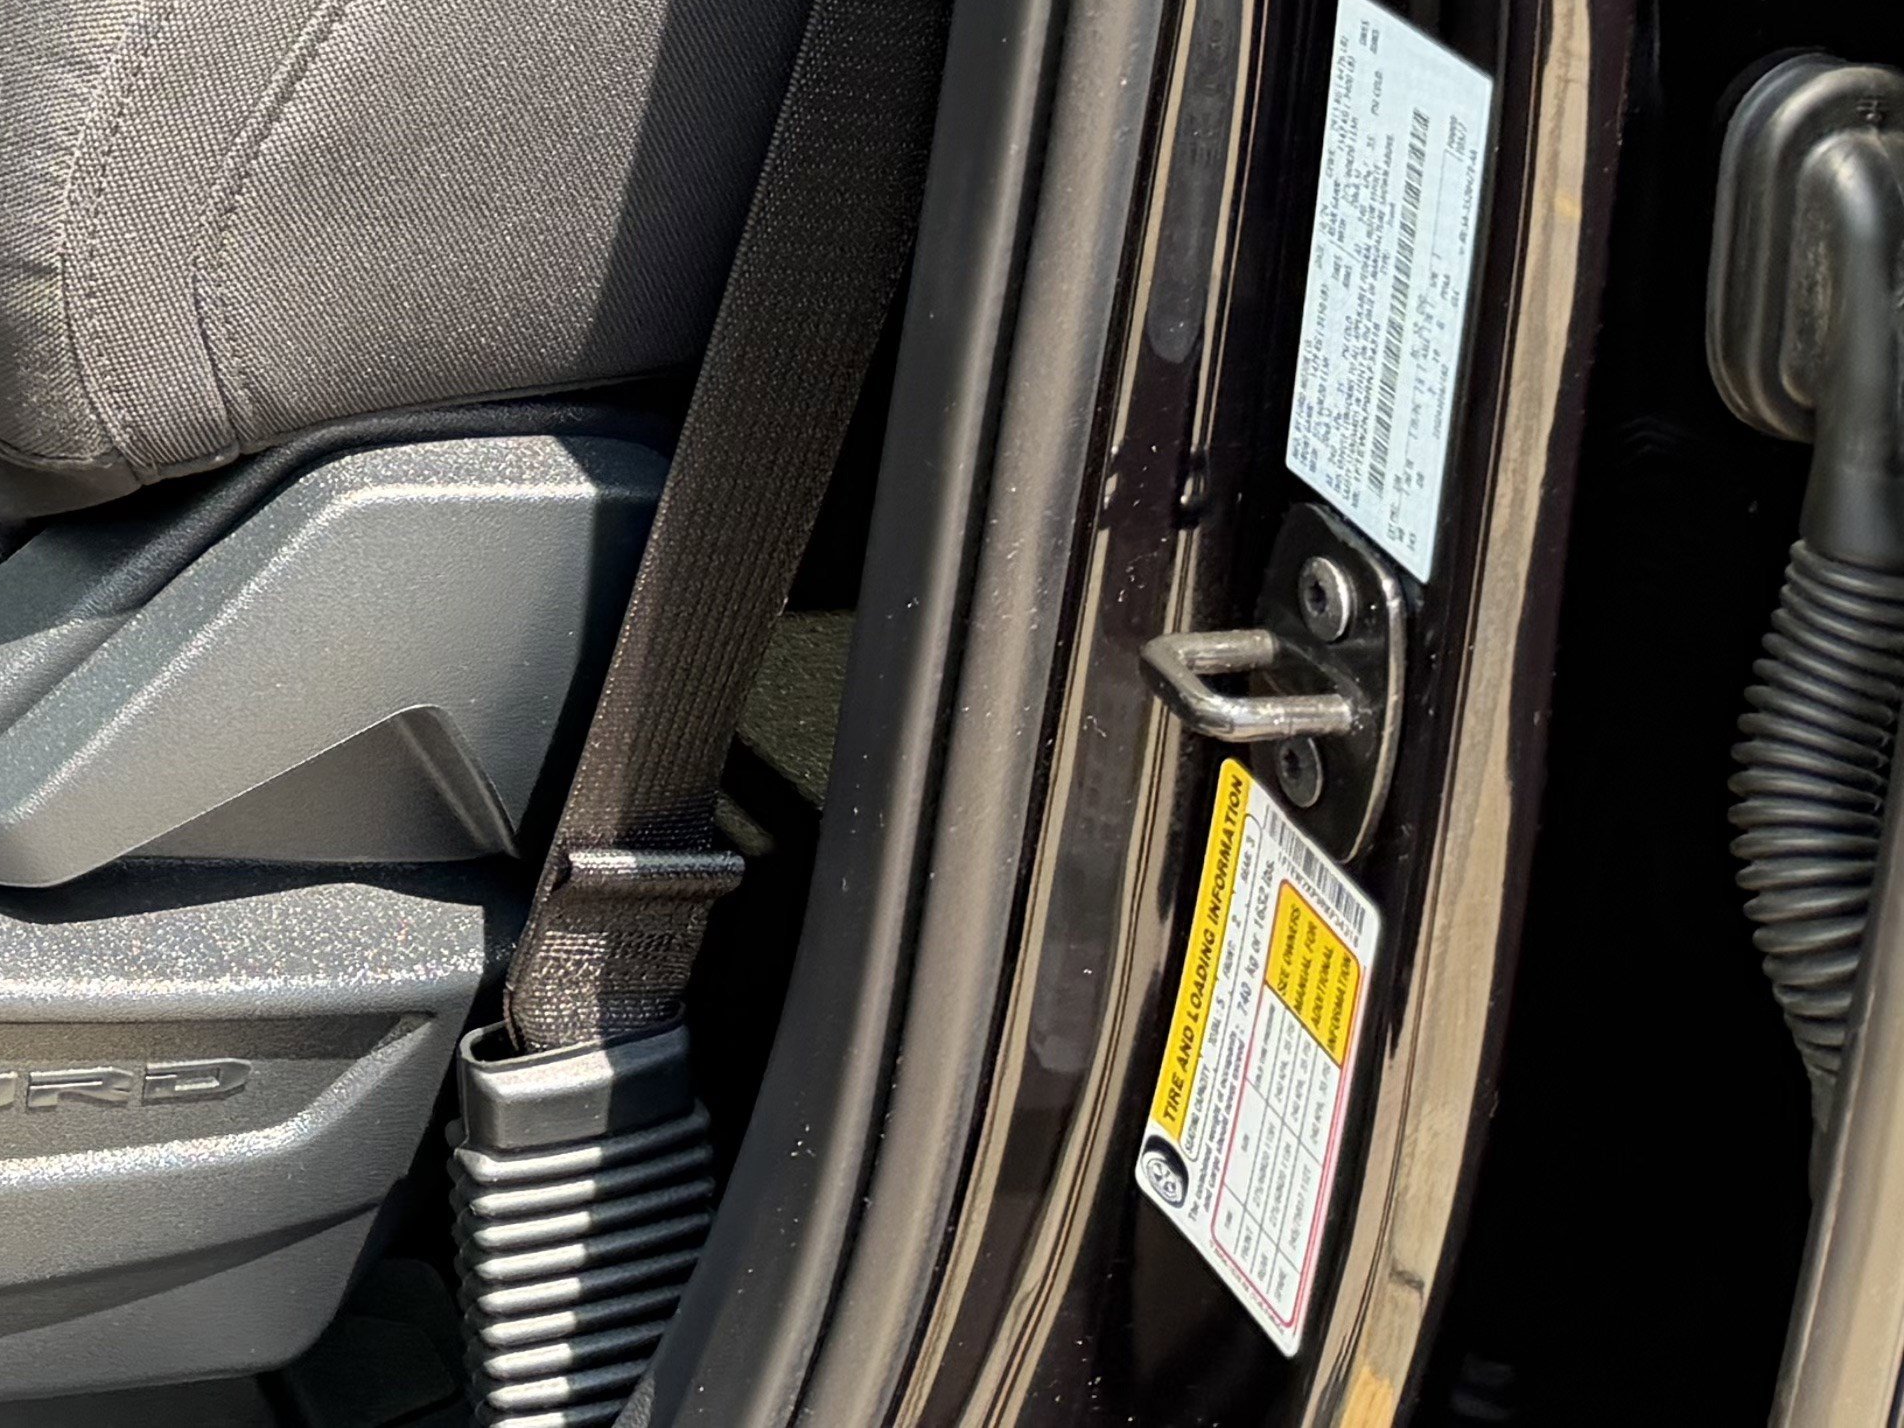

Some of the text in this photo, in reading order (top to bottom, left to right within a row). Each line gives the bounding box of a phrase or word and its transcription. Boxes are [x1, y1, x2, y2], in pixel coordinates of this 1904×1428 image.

[1163, 771, 1243, 1128] TIRE AND LOADING INFORMATION
[1276, 965, 1289, 997] SEE
[1291, 918, 1317, 1016] MANUAL FOR
[1309, 943, 1334, 1030] ADDITIONAL
[1325, 951, 1352, 1053] INFORMATION
